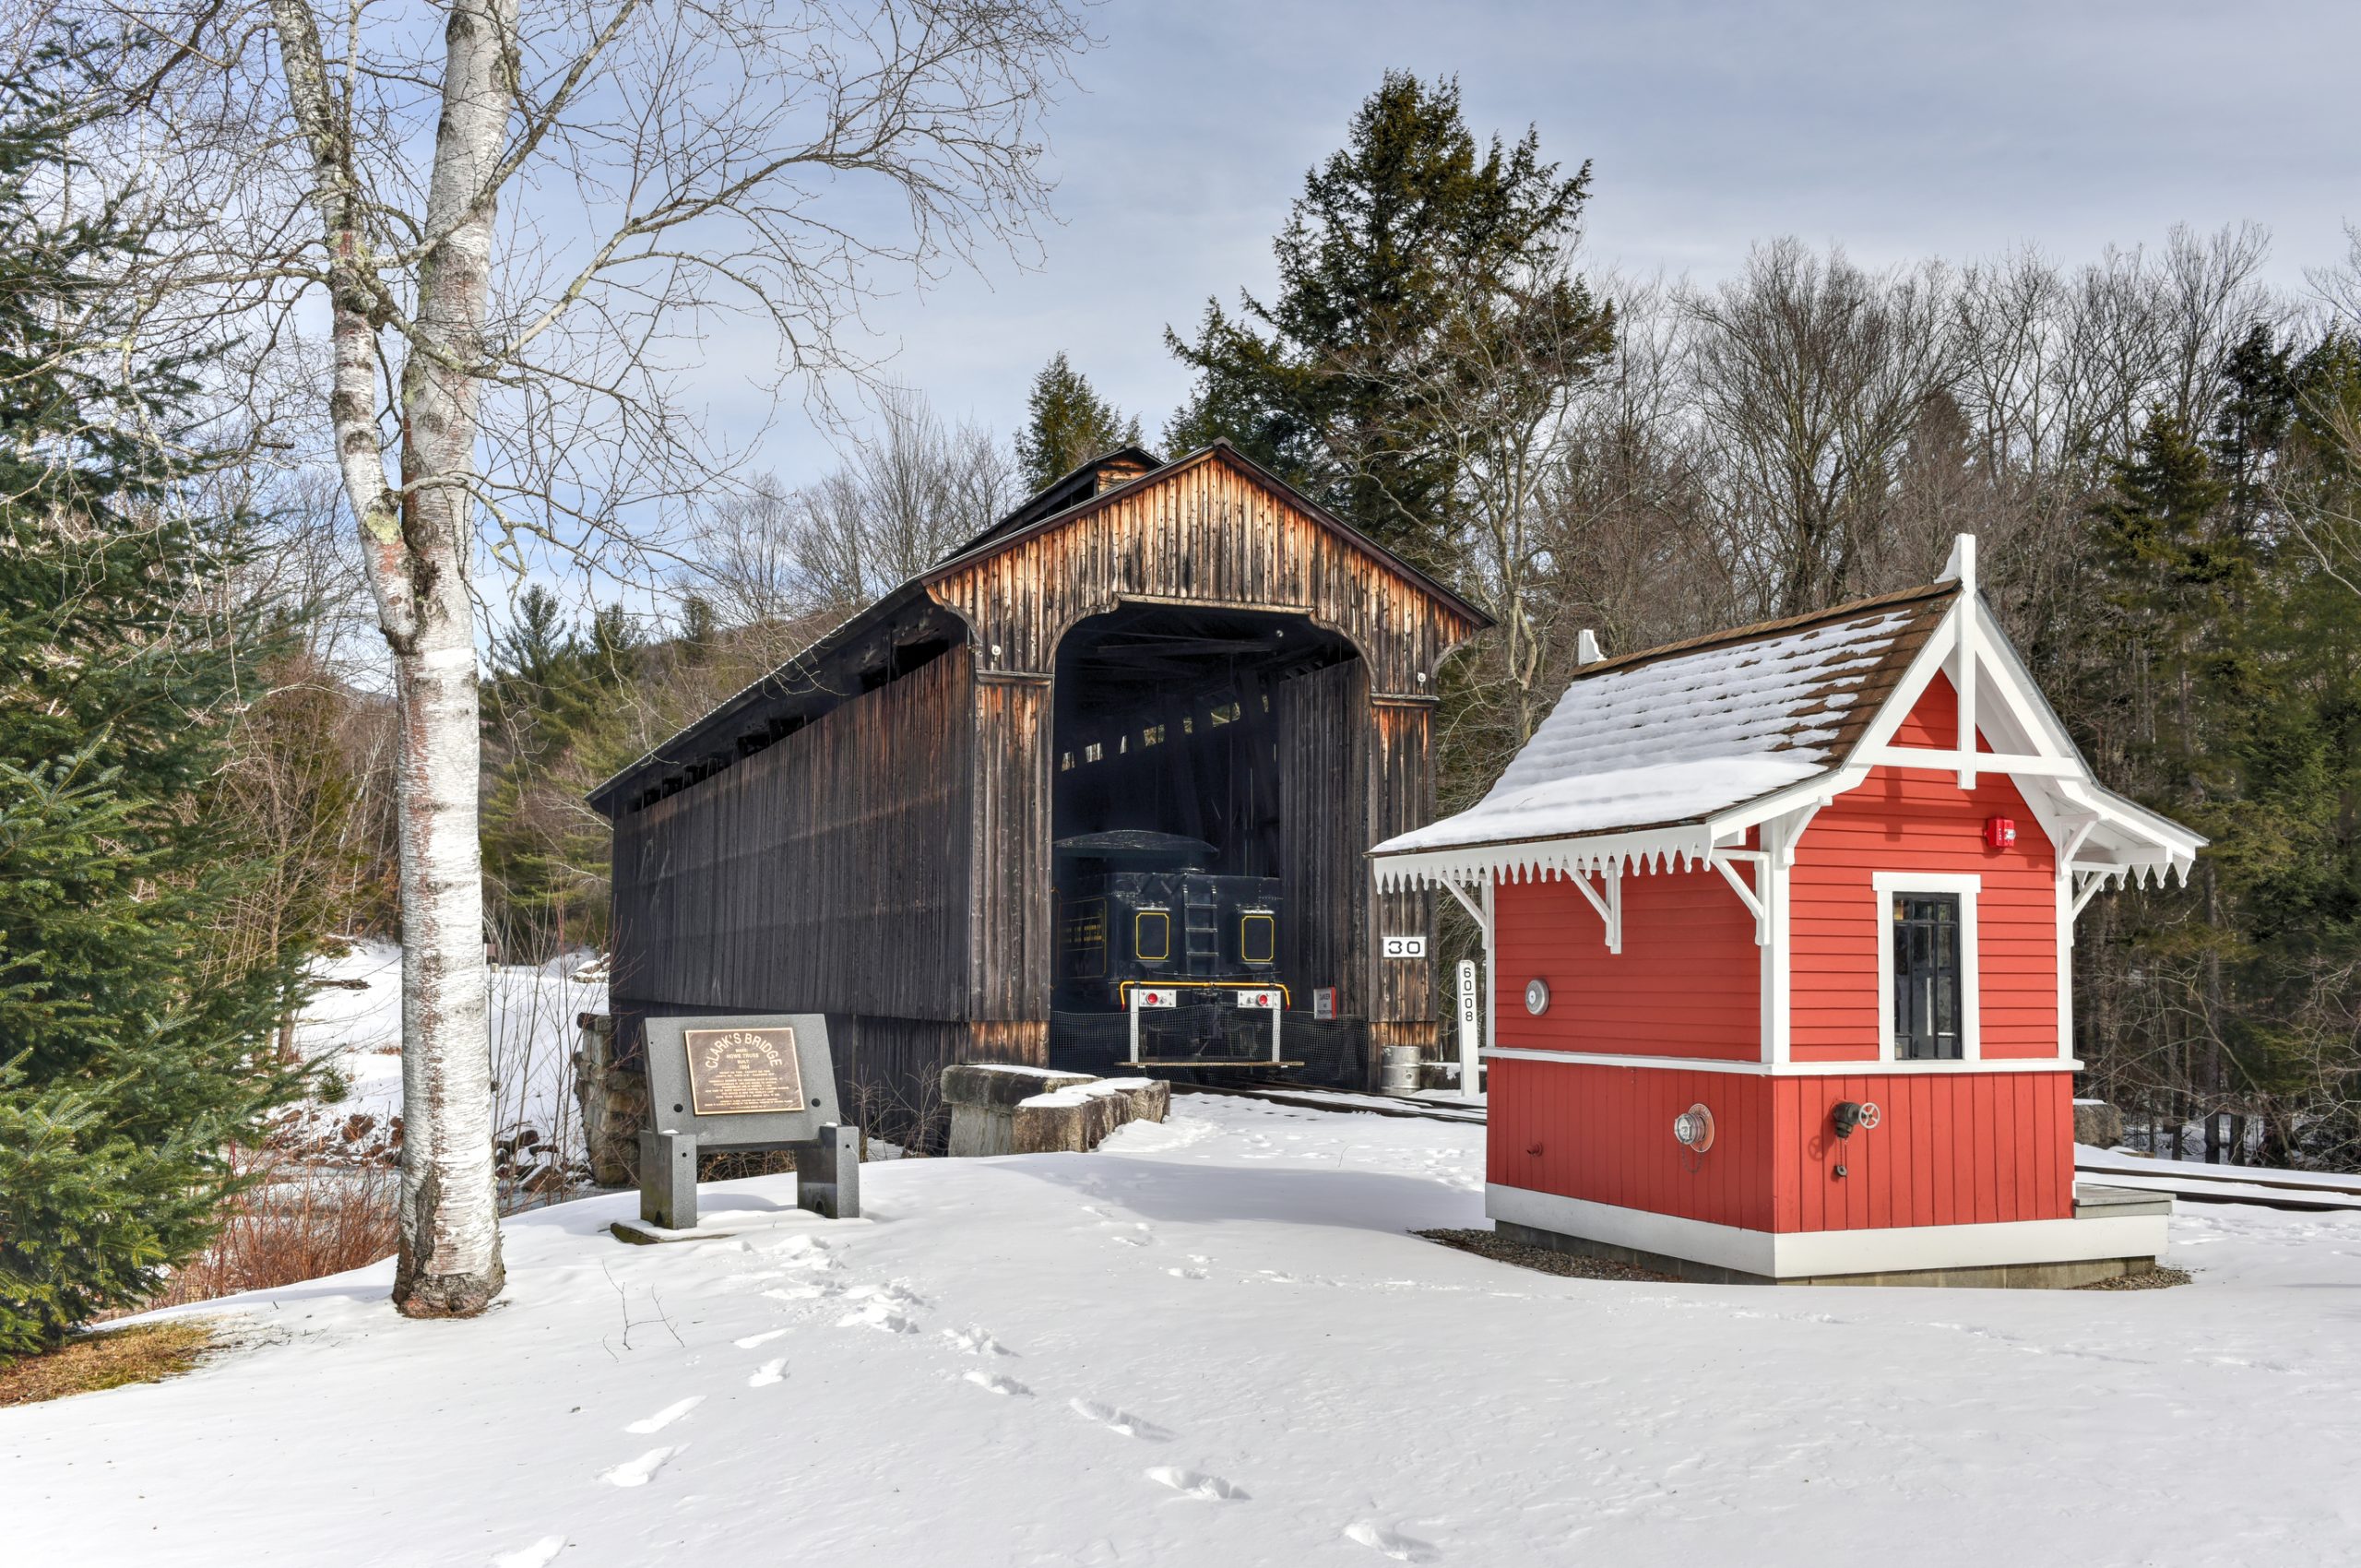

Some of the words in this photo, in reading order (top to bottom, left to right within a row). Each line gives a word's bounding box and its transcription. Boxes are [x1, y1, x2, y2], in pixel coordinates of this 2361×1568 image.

[1388, 941, 1421, 955] 30
[705, 1032, 742, 1068] CLARK'S
[744, 1032, 783, 1066] BRIDGE
